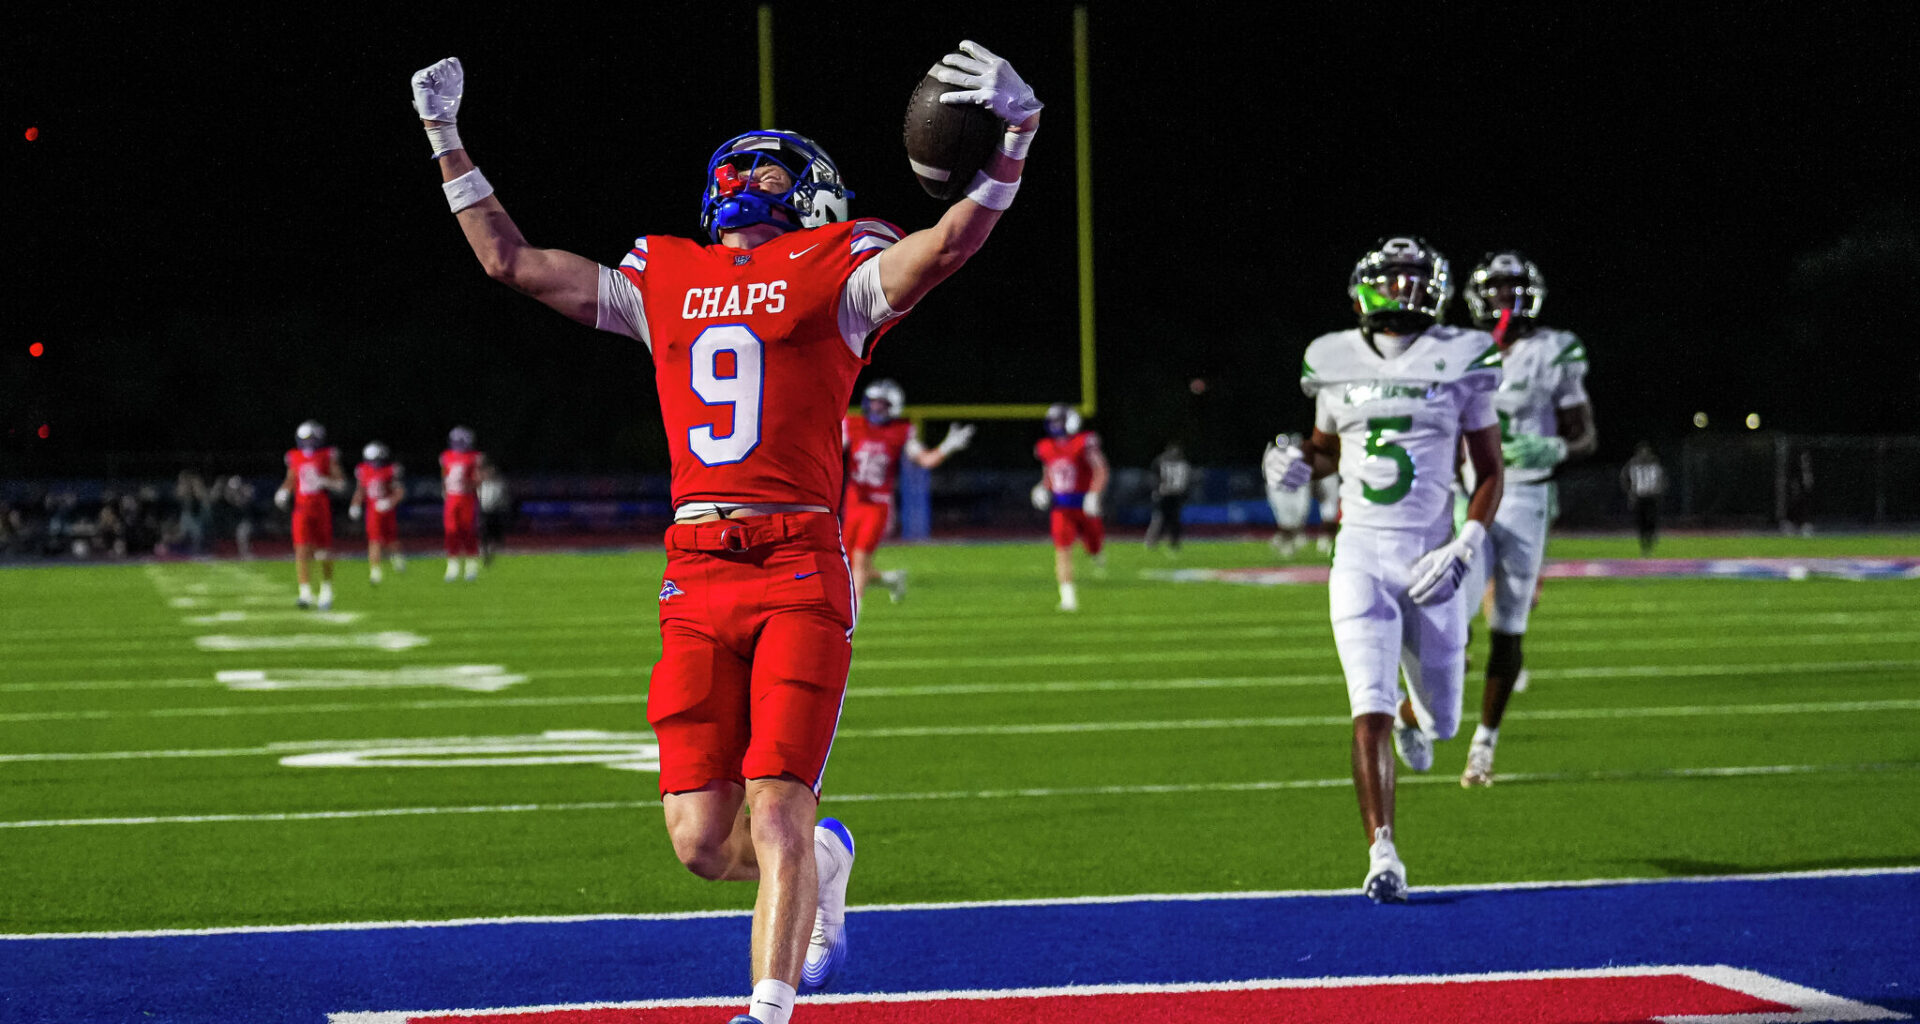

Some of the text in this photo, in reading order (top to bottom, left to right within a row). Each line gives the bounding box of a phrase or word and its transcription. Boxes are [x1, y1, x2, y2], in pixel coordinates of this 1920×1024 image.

[682, 280, 787, 320] CHAPS
[689, 323, 764, 467] 9
[1362, 416, 1415, 505] 5
